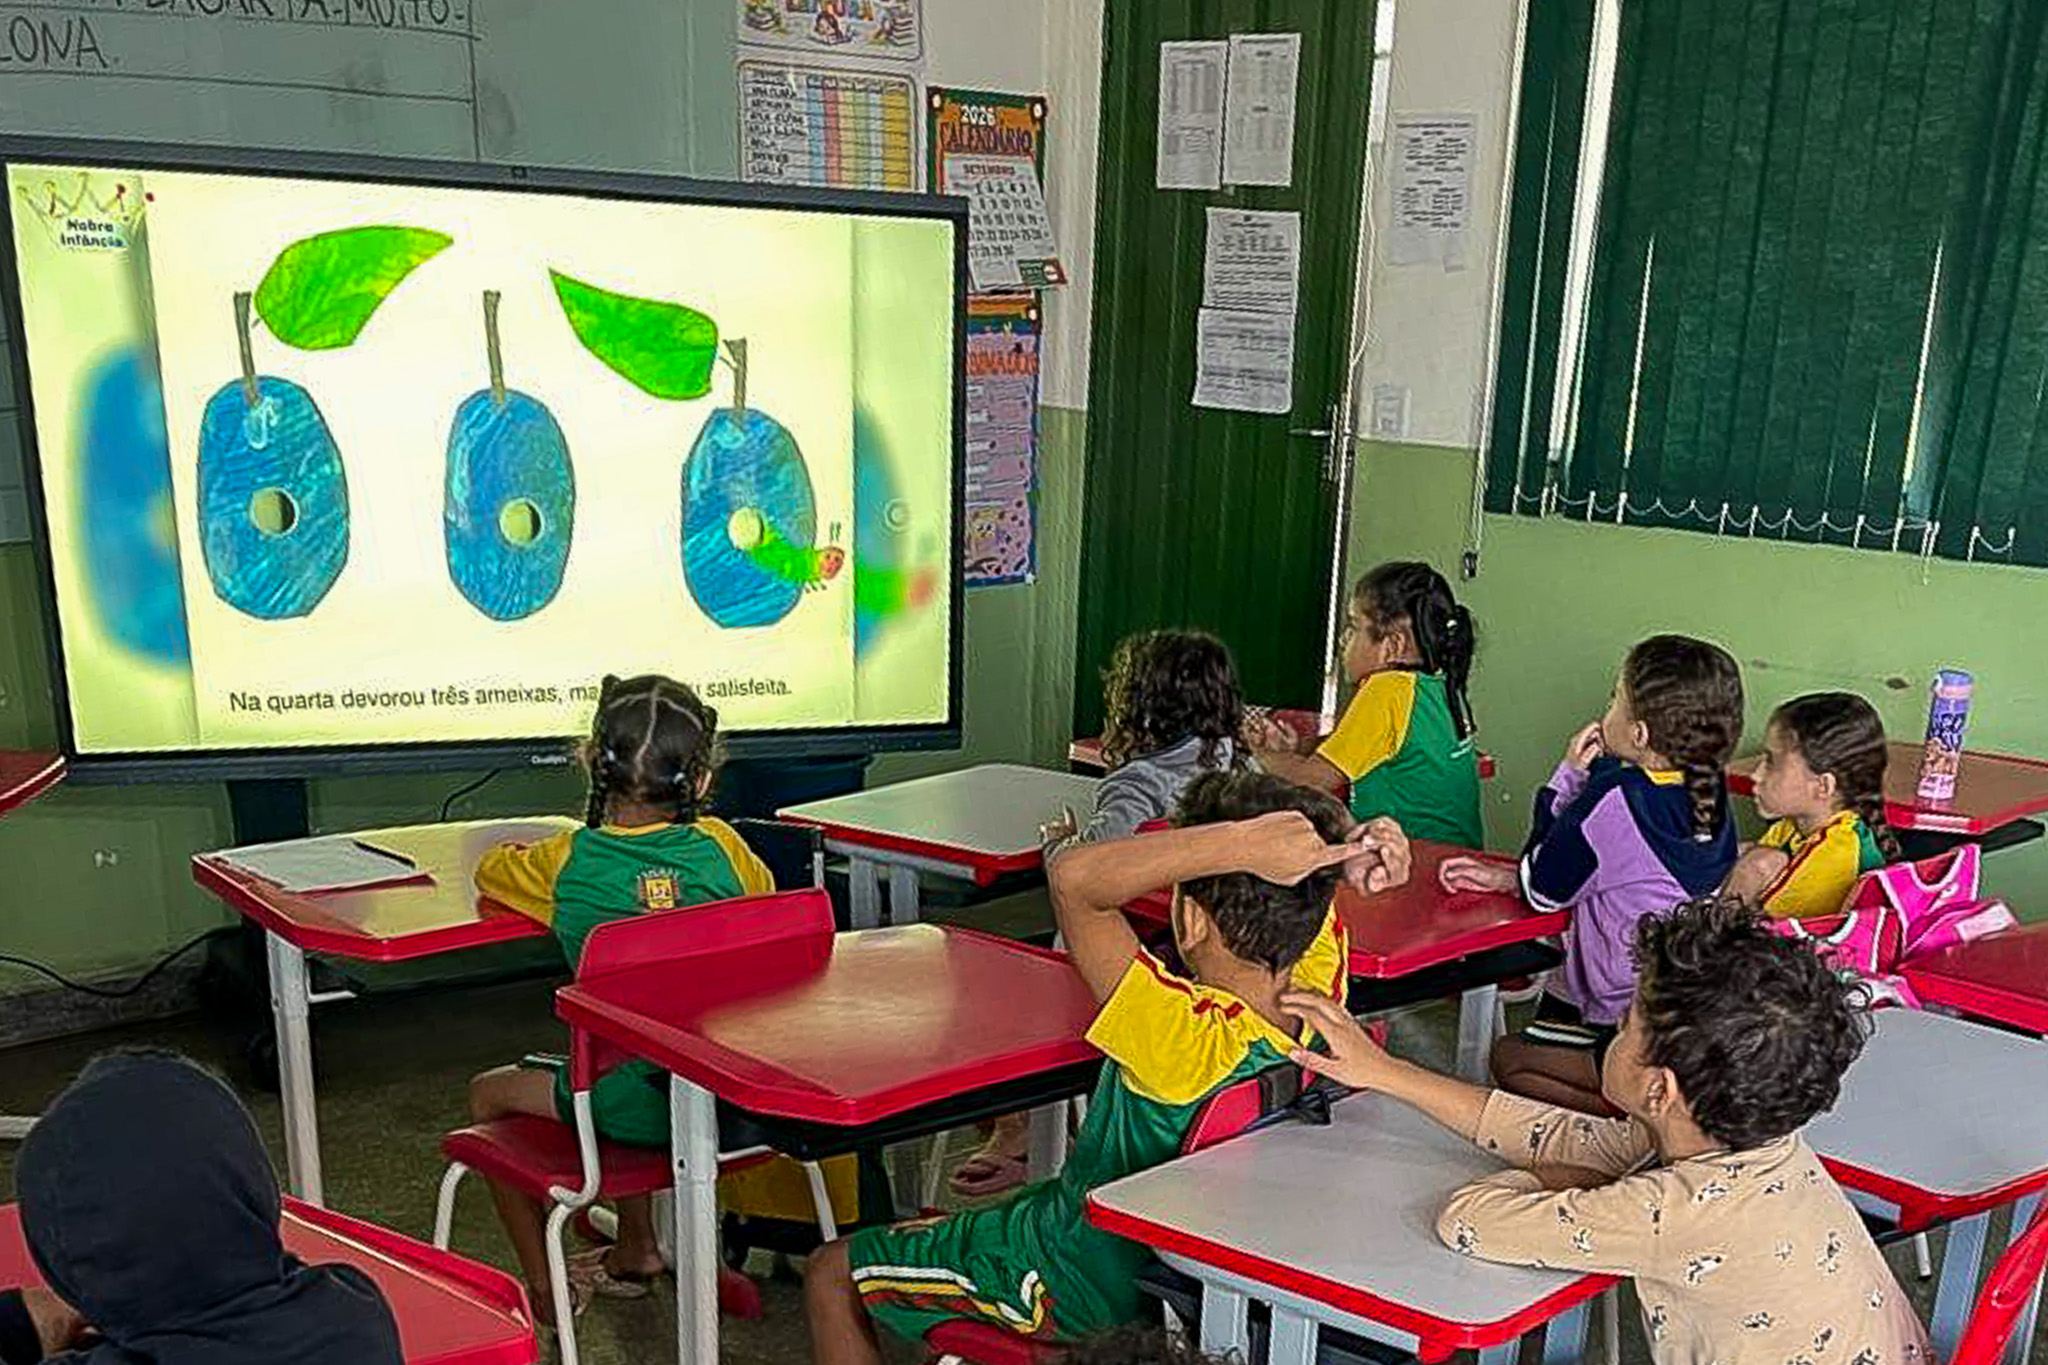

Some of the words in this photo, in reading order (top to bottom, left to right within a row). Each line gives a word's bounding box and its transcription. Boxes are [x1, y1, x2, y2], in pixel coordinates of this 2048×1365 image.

[229, 691, 262, 712] Na
[267, 691, 336, 714] quarta
[340, 688, 425, 709] devorou
[430, 685, 470, 706] três
[475, 682, 564, 706] ameixas,
[568, 685, 600, 702] ma
[705, 676, 793, 699] satisfeita.
